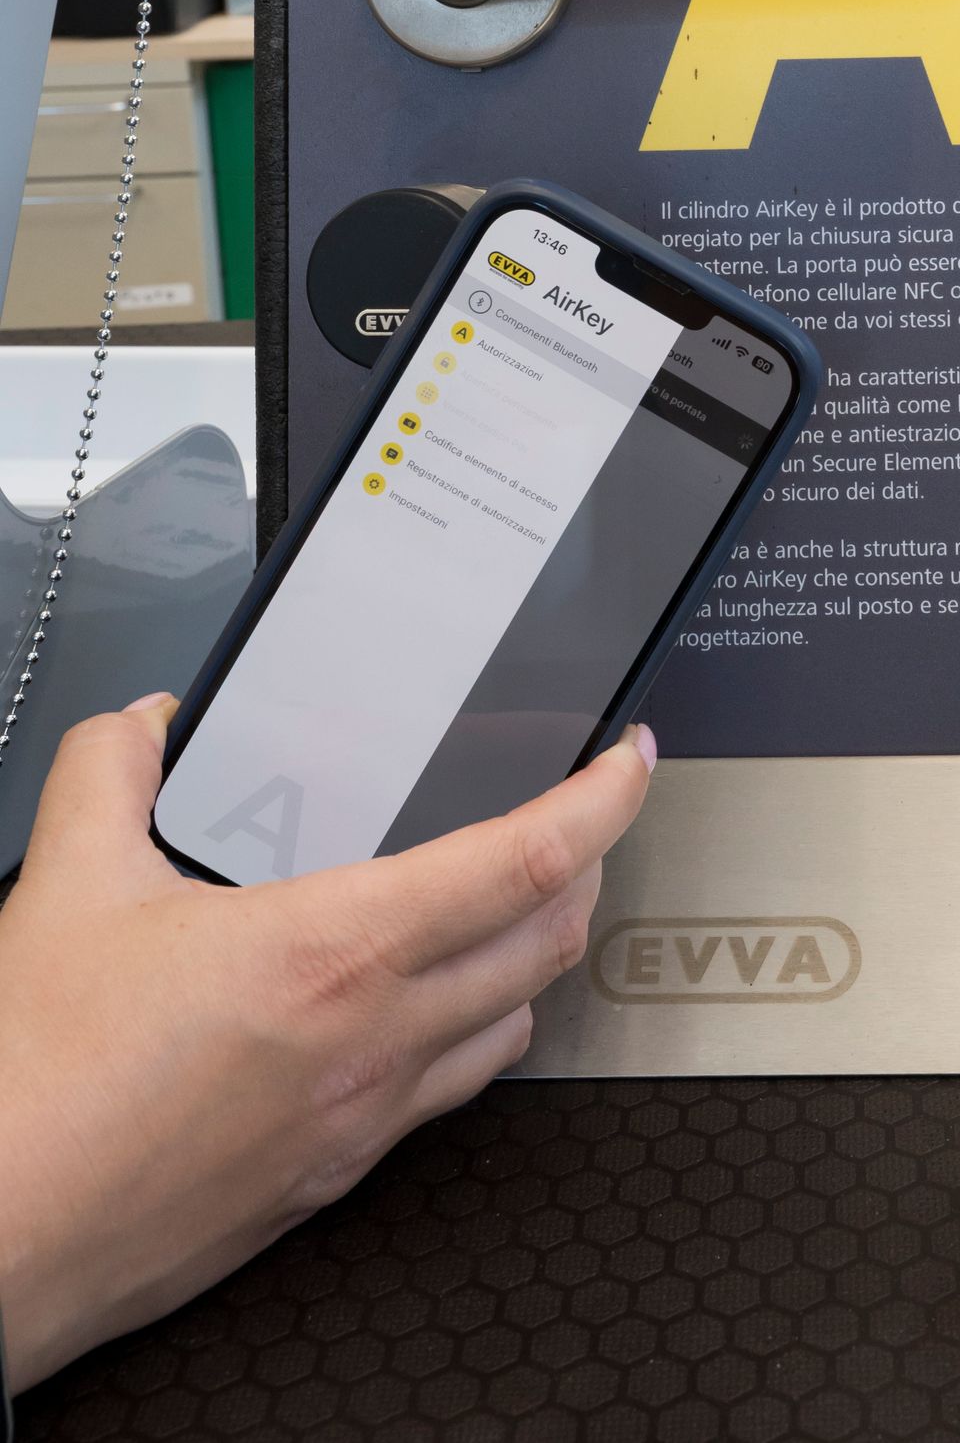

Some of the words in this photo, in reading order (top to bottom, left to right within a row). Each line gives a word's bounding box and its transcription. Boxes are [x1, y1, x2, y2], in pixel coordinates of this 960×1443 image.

[662, 201, 671, 220] Il
[678, 200, 749, 219] cilindro
[756, 200, 818, 222] AirKey
[825, 199, 836, 216] è
[843, 198, 852, 216] il
[860, 197, 946, 221] prodotto
[533, 229, 569, 256] 13:46
[662, 229, 743, 250] pregiato
[750, 232, 781, 251] per
[788, 227, 803, 245] la
[811, 226, 891, 245] chiusura
[898, 225, 953, 243] sicura
[493, 255, 530, 283] EVVA
[365, 315, 406, 330] EVV
[542, 285, 614, 336] AirKey
[495, 308, 552, 347] Componenti
[552, 341, 599, 374] Bluetooth
[477, 339, 545, 382] Autorizzazioni
[755, 358, 771, 372] 90
[828, 368, 851, 386] ha
[660, 389, 670, 400] la
[669, 397, 708, 422] portata
[824, 396, 890, 420] qualità
[897, 399, 951, 414] come
[424, 430, 463, 458] Codifica
[464, 453, 508, 483] elemento
[509, 479, 520, 489] di
[519, 485, 558, 512] accesso
[388, 490, 449, 530] Impostazioni
[406, 459, 470, 502] Registrazione
[471, 498, 482, 508] di
[481, 504, 546, 546] autorizzazioni
[675, 629, 809, 651] rogettazione.
[624, 935, 832, 984] EVVA
